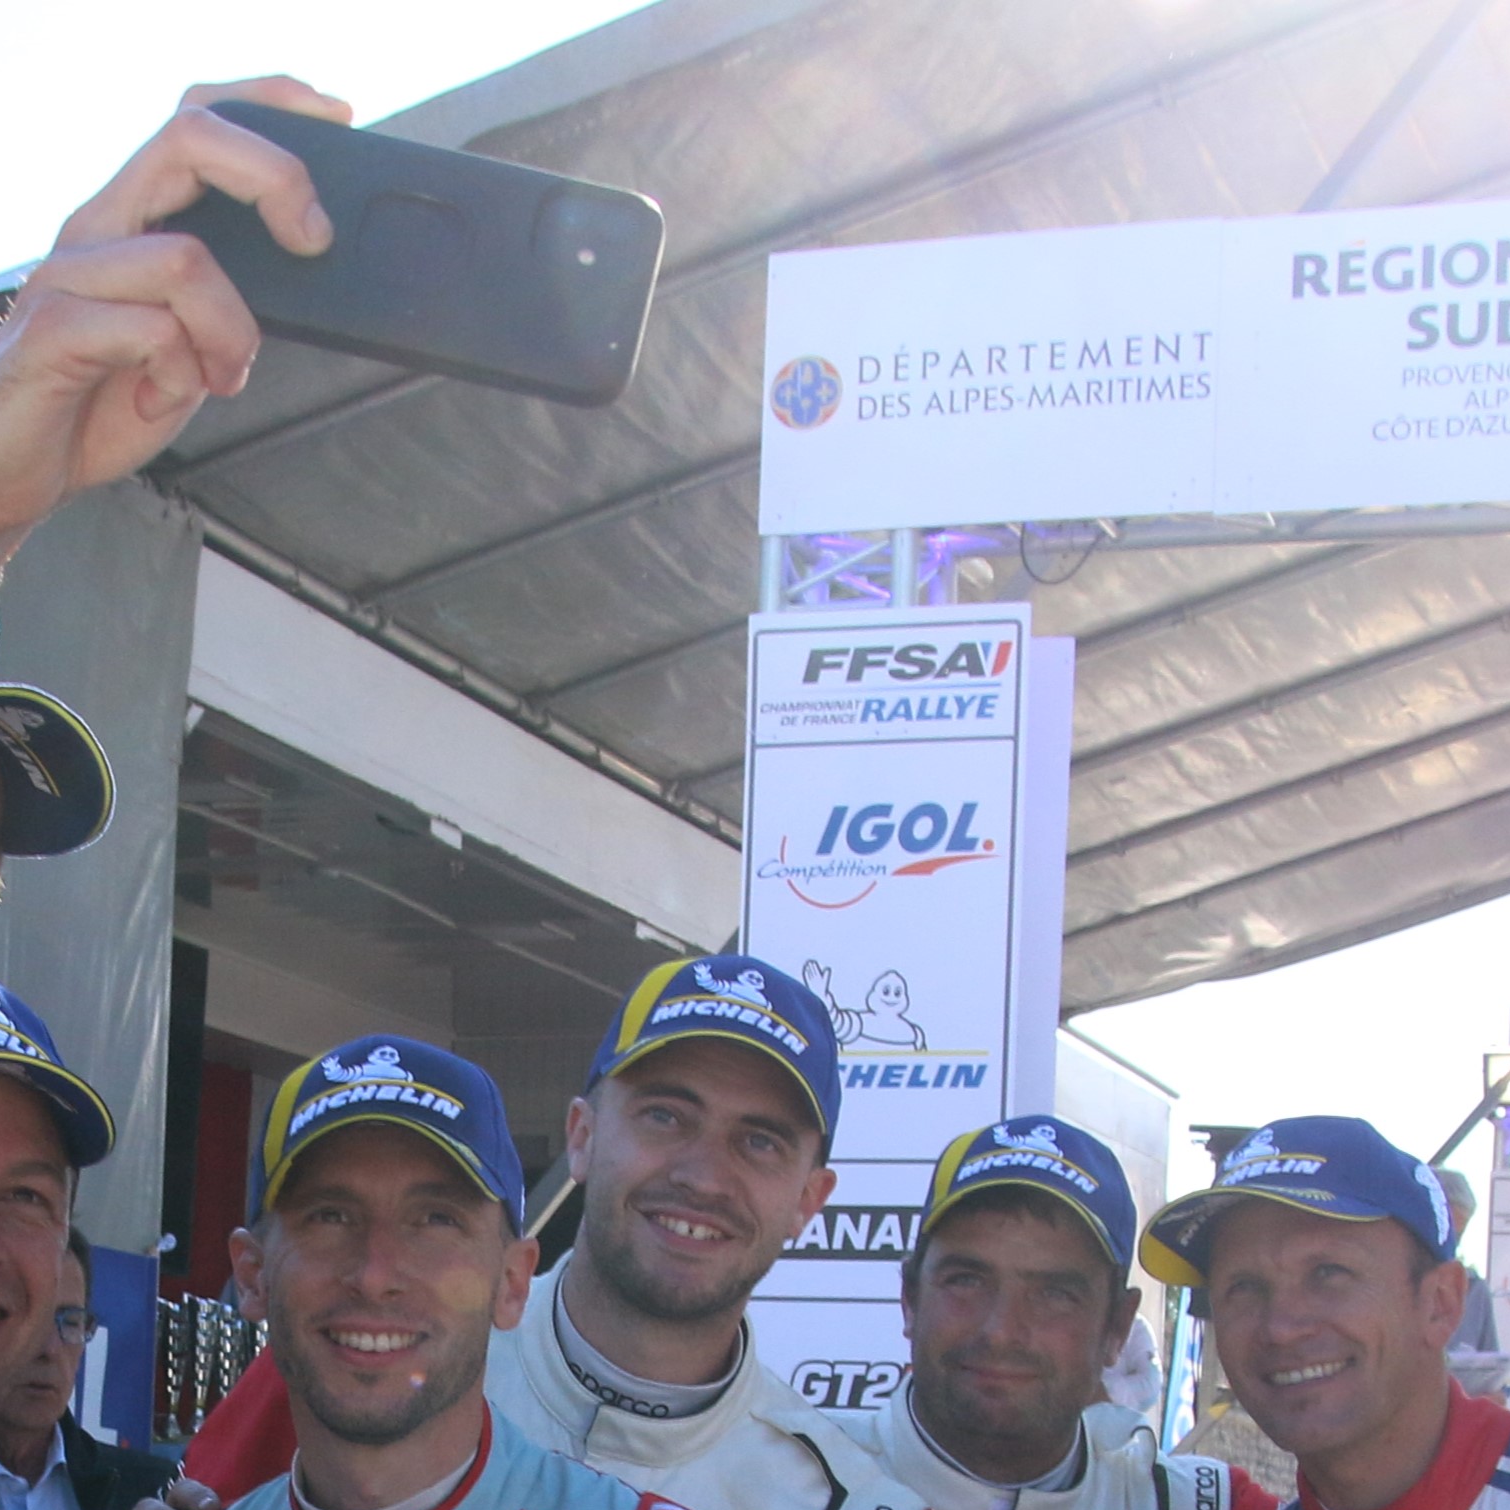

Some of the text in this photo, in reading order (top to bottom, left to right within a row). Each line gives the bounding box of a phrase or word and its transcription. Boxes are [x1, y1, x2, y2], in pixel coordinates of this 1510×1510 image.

[857, 331, 1212, 385] DÉPARTEMENT
[857, 371, 1212, 422] DES ALPES-MARITIMES
[1372, 414, 1441, 443] CÔTE
[802, 642, 984, 684] FFSA
[760, 694, 998, 723] CHAMPIONNAT RALLYE
[780, 713, 856, 727] DE FRANCE
[757, 859, 888, 883] Compétition
[652, 1000, 805, 1056] MICHELIN
[838, 1063, 987, 1089] HELIN
[291, 1083, 462, 1137] MICHELIN
[957, 1154, 1097, 1194] MICHELIN
